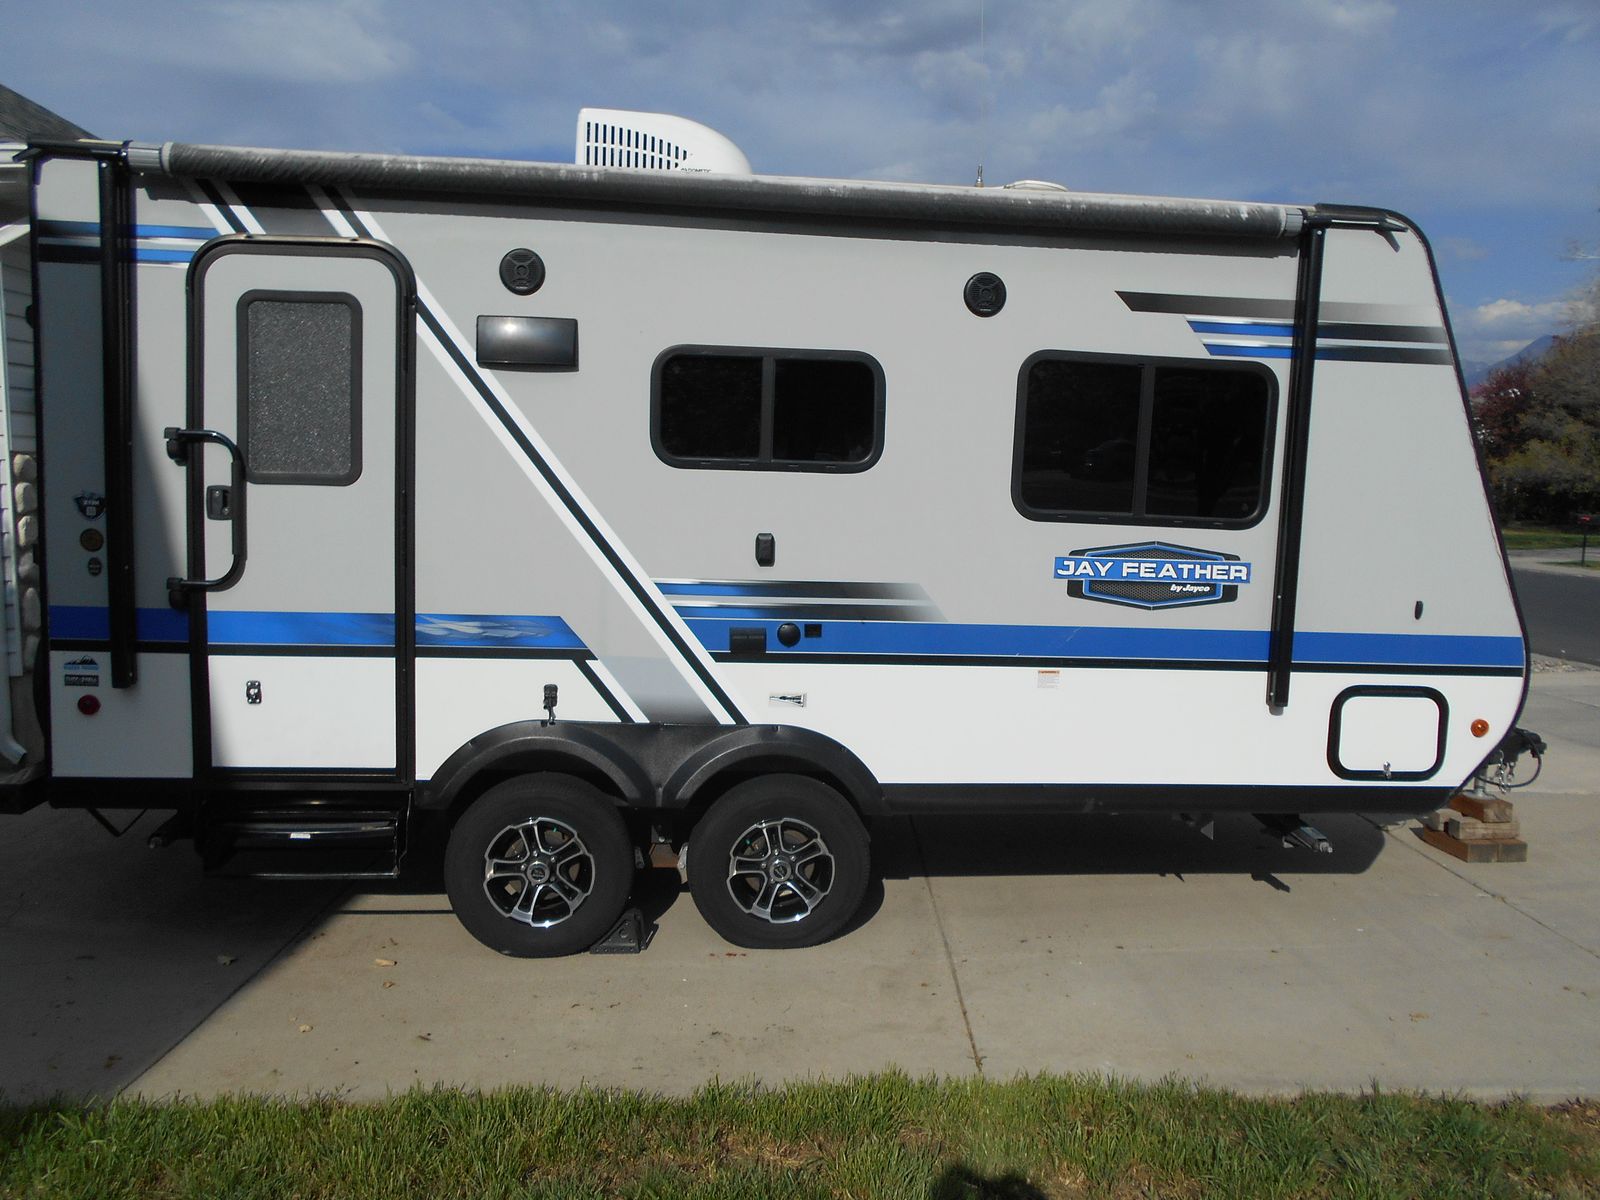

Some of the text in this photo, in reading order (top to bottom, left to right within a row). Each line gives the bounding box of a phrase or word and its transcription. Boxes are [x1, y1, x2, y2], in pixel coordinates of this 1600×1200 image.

[1057, 560, 1248, 580] JAY FEATHER
[1170, 584, 1210, 592] by Jayco
